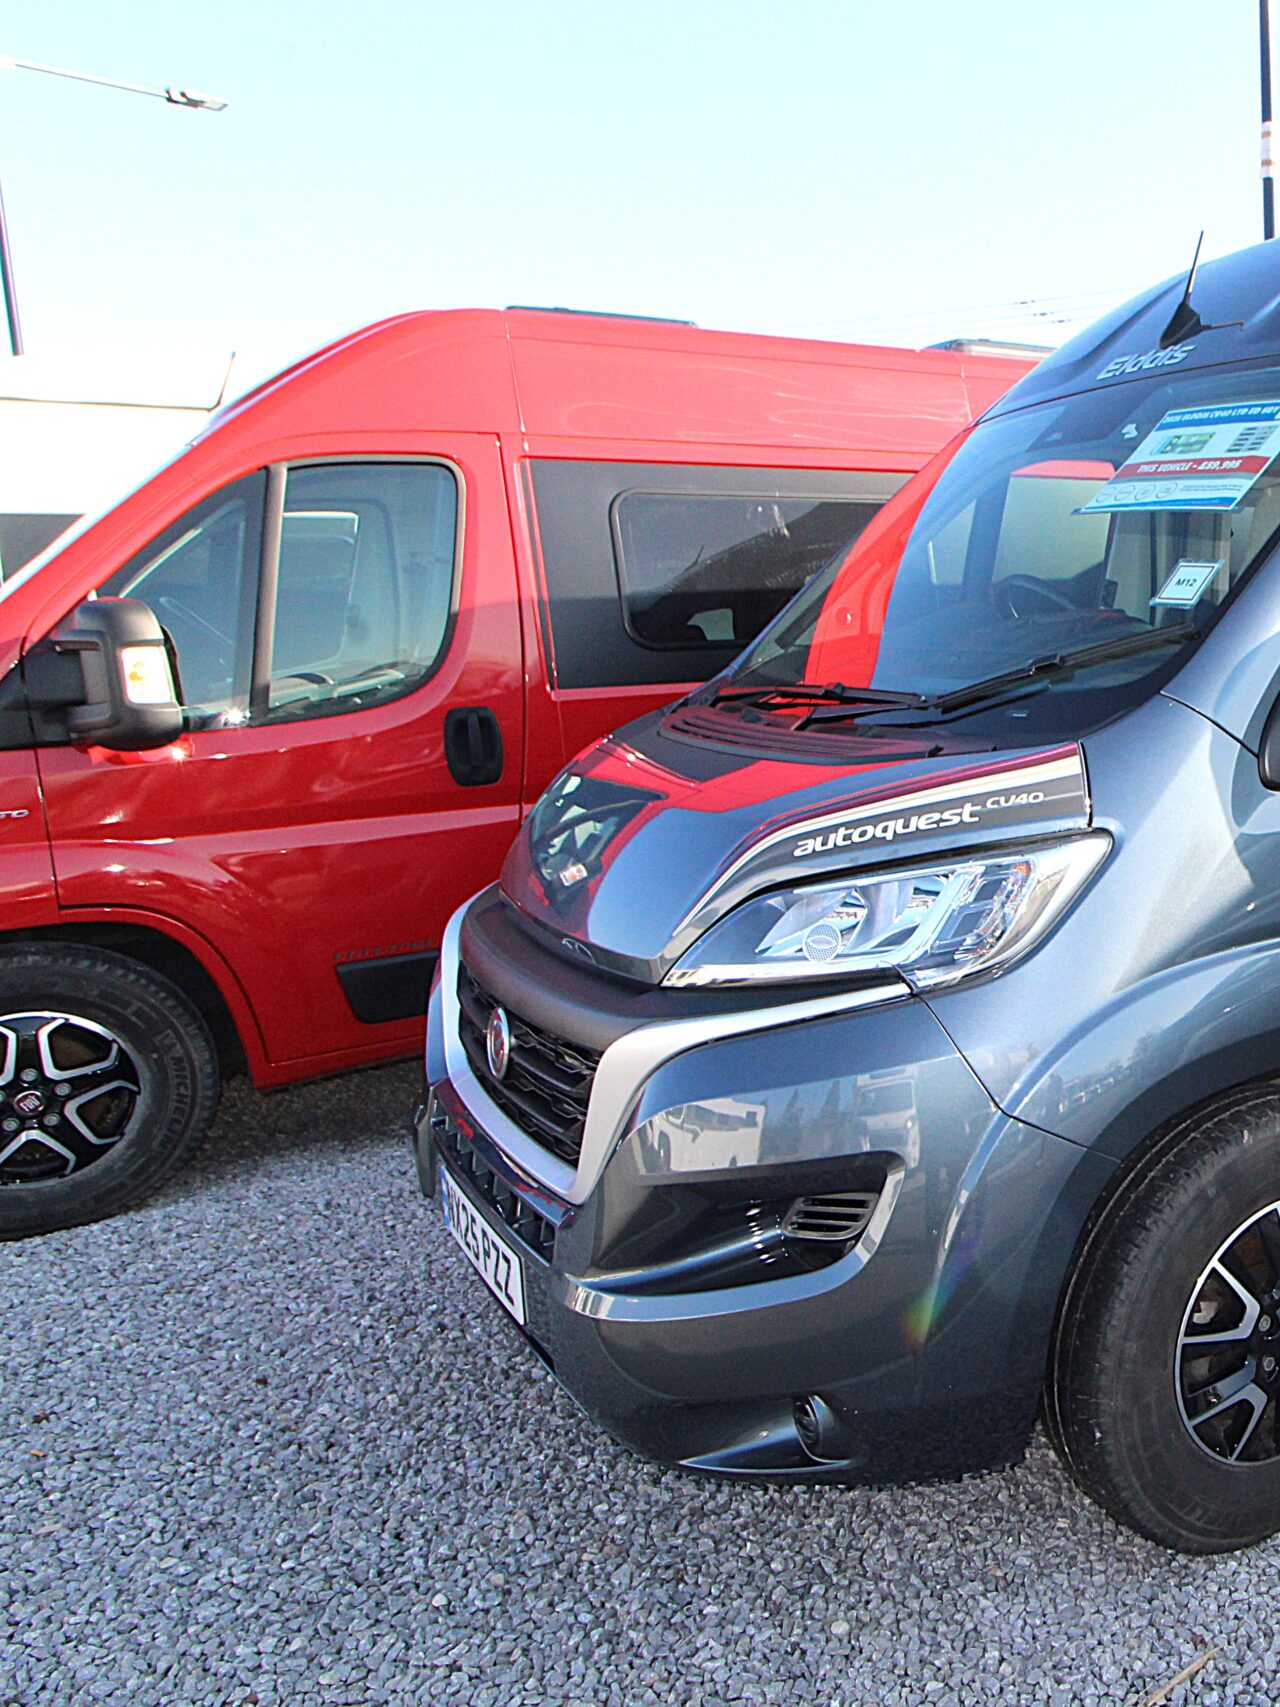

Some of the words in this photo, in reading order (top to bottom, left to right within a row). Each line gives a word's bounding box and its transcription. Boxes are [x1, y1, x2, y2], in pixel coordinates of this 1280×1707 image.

[1096, 343, 1197, 380] Elddis
[1137, 464, 1158, 472] THIS
[1157, 462, 1193, 472] VEHICLE
[1174, 578, 1197, 587] M12
[793, 802, 981, 857] autoquest
[985, 791, 1045, 810] CV40
[481, 1226, 515, 1307] PZZ
